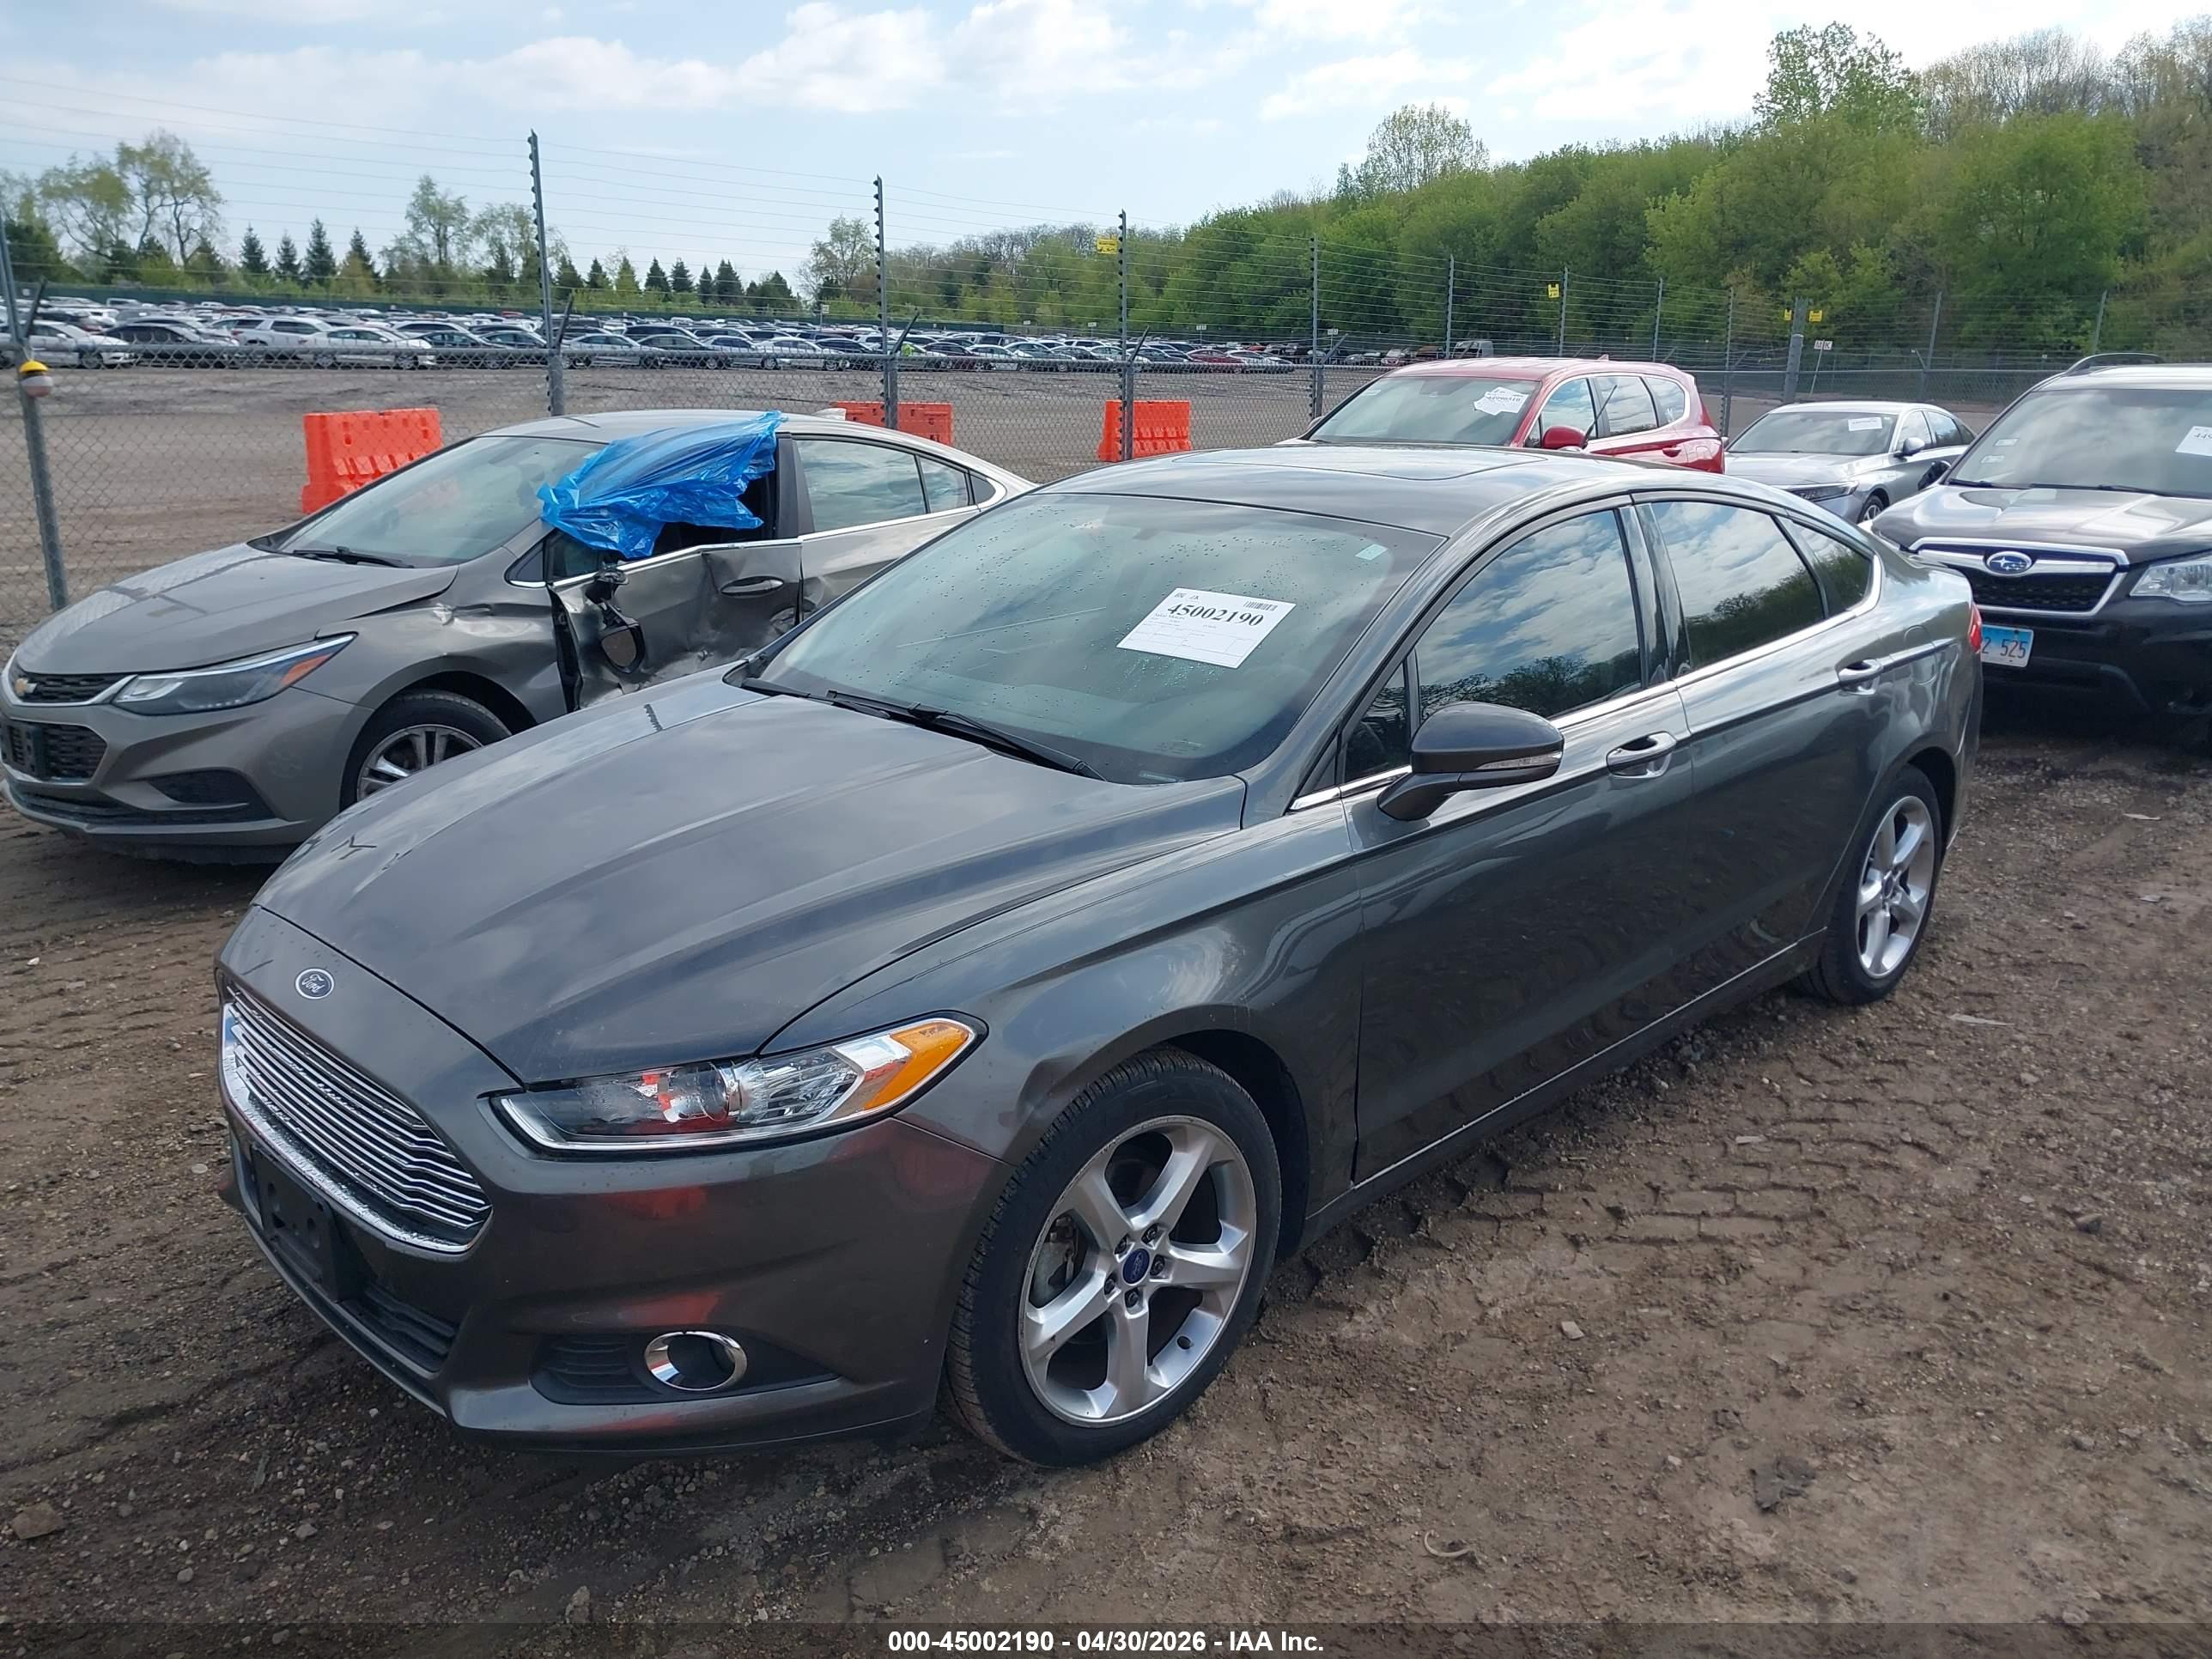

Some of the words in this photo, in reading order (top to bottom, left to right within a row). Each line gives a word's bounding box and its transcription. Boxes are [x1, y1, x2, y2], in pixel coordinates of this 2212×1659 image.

[1167, 604, 1265, 626] 45002190
[2000, 639, 2027, 659] 525
[301, 974, 325, 993] Ford
